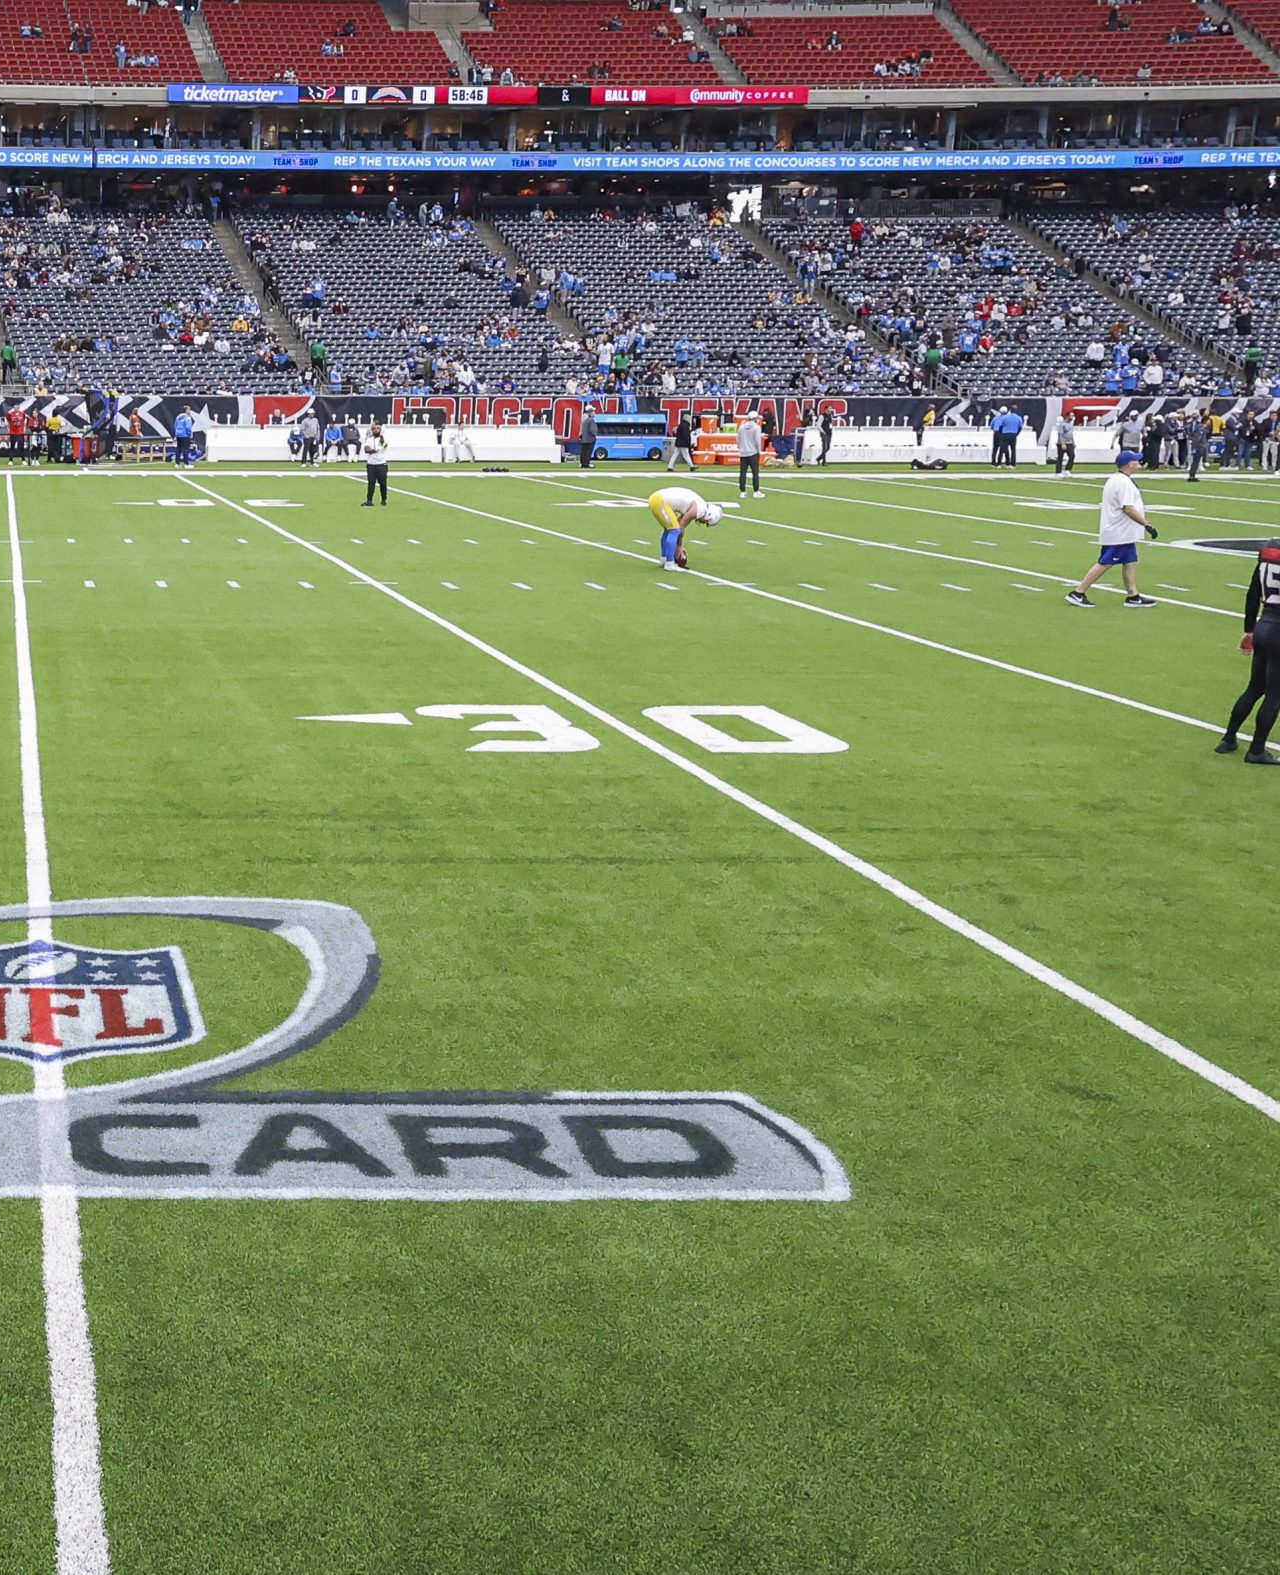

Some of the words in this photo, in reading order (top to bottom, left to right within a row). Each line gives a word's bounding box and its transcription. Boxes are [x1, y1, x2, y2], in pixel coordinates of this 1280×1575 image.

[183, 86, 276, 102] ticketmaster
[351, 89, 358, 101] 0
[420, 89, 427, 101] 0
[451, 89, 484, 101] 58:46
[605, 88, 630, 102] BALL
[631, 88, 646, 102] ON
[690, 88, 745, 103] Community
[746, 92, 795, 100] COFFEE
[9, 152, 49, 163] SCORE
[52, 153, 81, 164] NEW
[131, 154, 158, 165] AND
[160, 154, 211, 166] JERSEYS
[213, 154, 256, 166] TODAY!
[333, 155, 357, 167] REP
[359, 155, 382, 167] THE
[384, 156, 432, 167] TEXANS
[434, 156, 467, 167] YOUR
[469, 156, 497, 167] WAY
[573, 157, 603, 168] VISIT
[605, 157, 638, 168] TEAM
[640, 157, 680, 169] SHOPS
[682, 157, 726, 168] ALONG
[728, 157, 752, 168] THE
[754, 156, 837, 168] CONCOURSES
[839, 156, 856, 167] TO
[858, 156, 900, 167] SCORE
[902, 156, 933, 167] NEW
[935, 155, 979, 167] MERCH
[981, 155, 1010, 166] AND
[1012, 154, 1066, 166] JERSEYS
[1069, 154, 1116, 165] TODAY!
[1201, 152, 1226, 163] REP
[1230, 152, 1255, 163] THE
[69, 1112, 738, 1179] CARD
